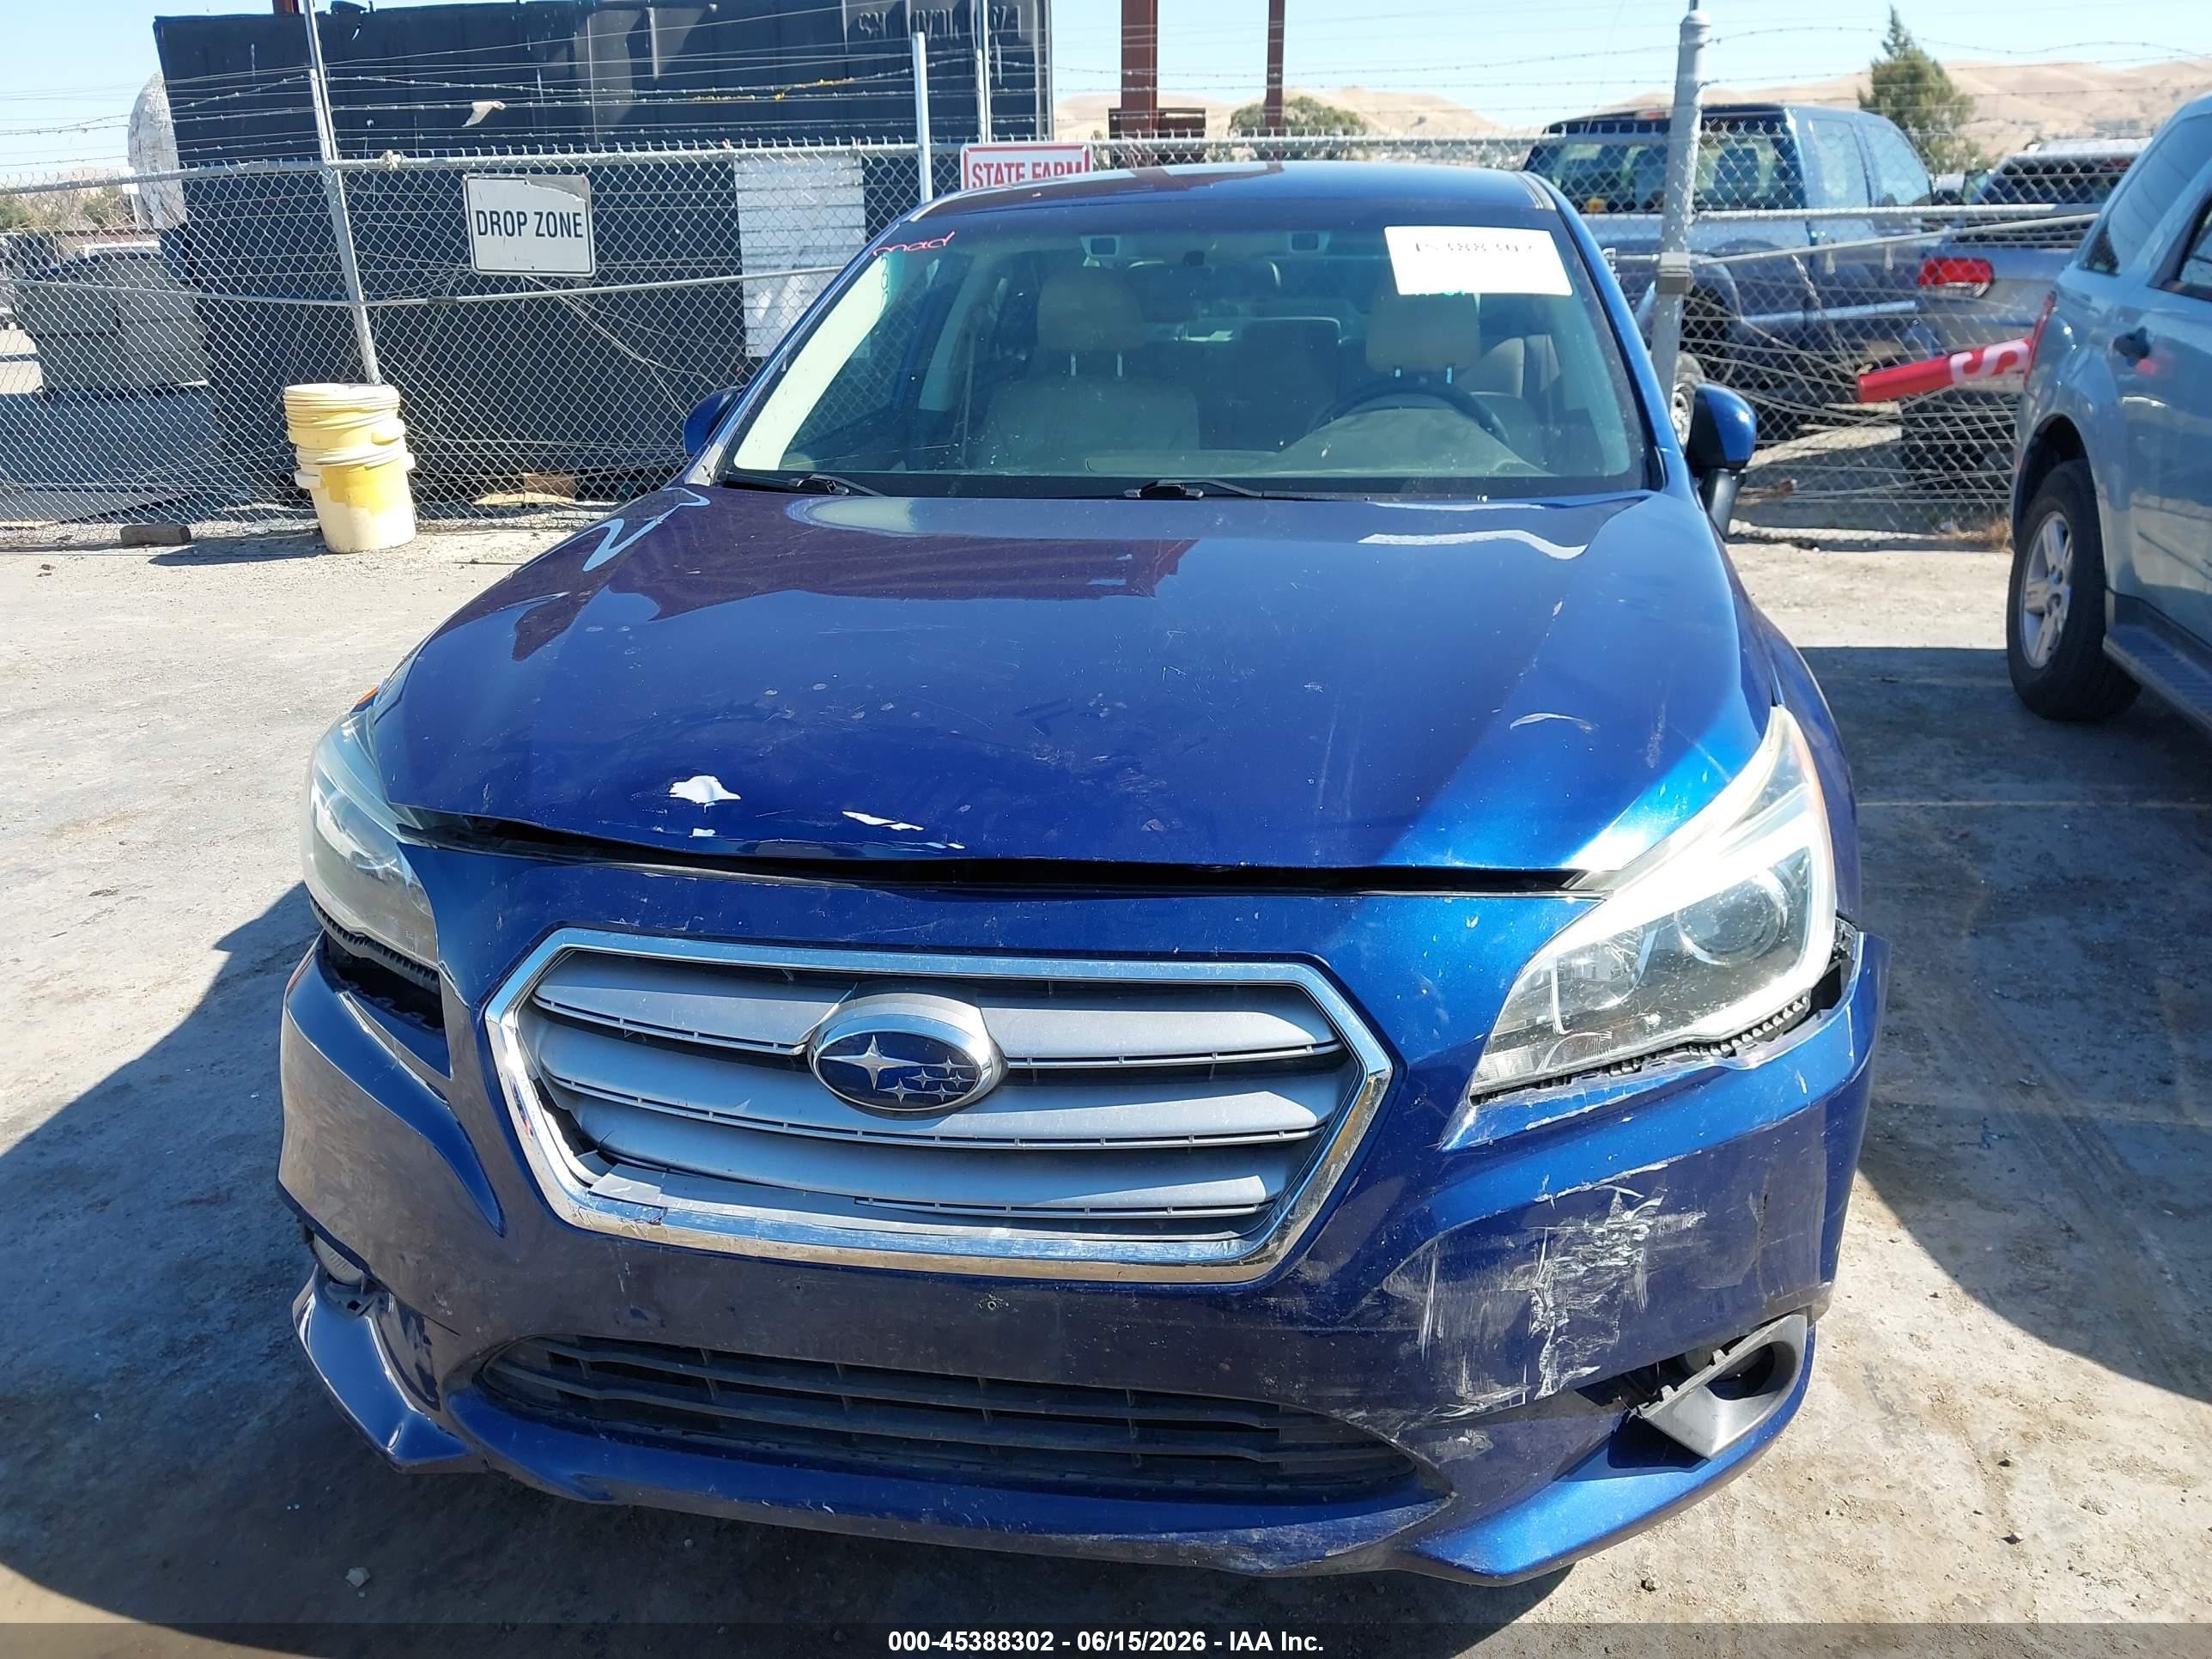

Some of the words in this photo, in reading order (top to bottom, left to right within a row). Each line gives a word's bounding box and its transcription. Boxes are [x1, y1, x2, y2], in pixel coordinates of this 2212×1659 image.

[972, 162, 1025, 189] STATE
[476, 210, 528, 237] DROP
[534, 211, 583, 238] ZONE
